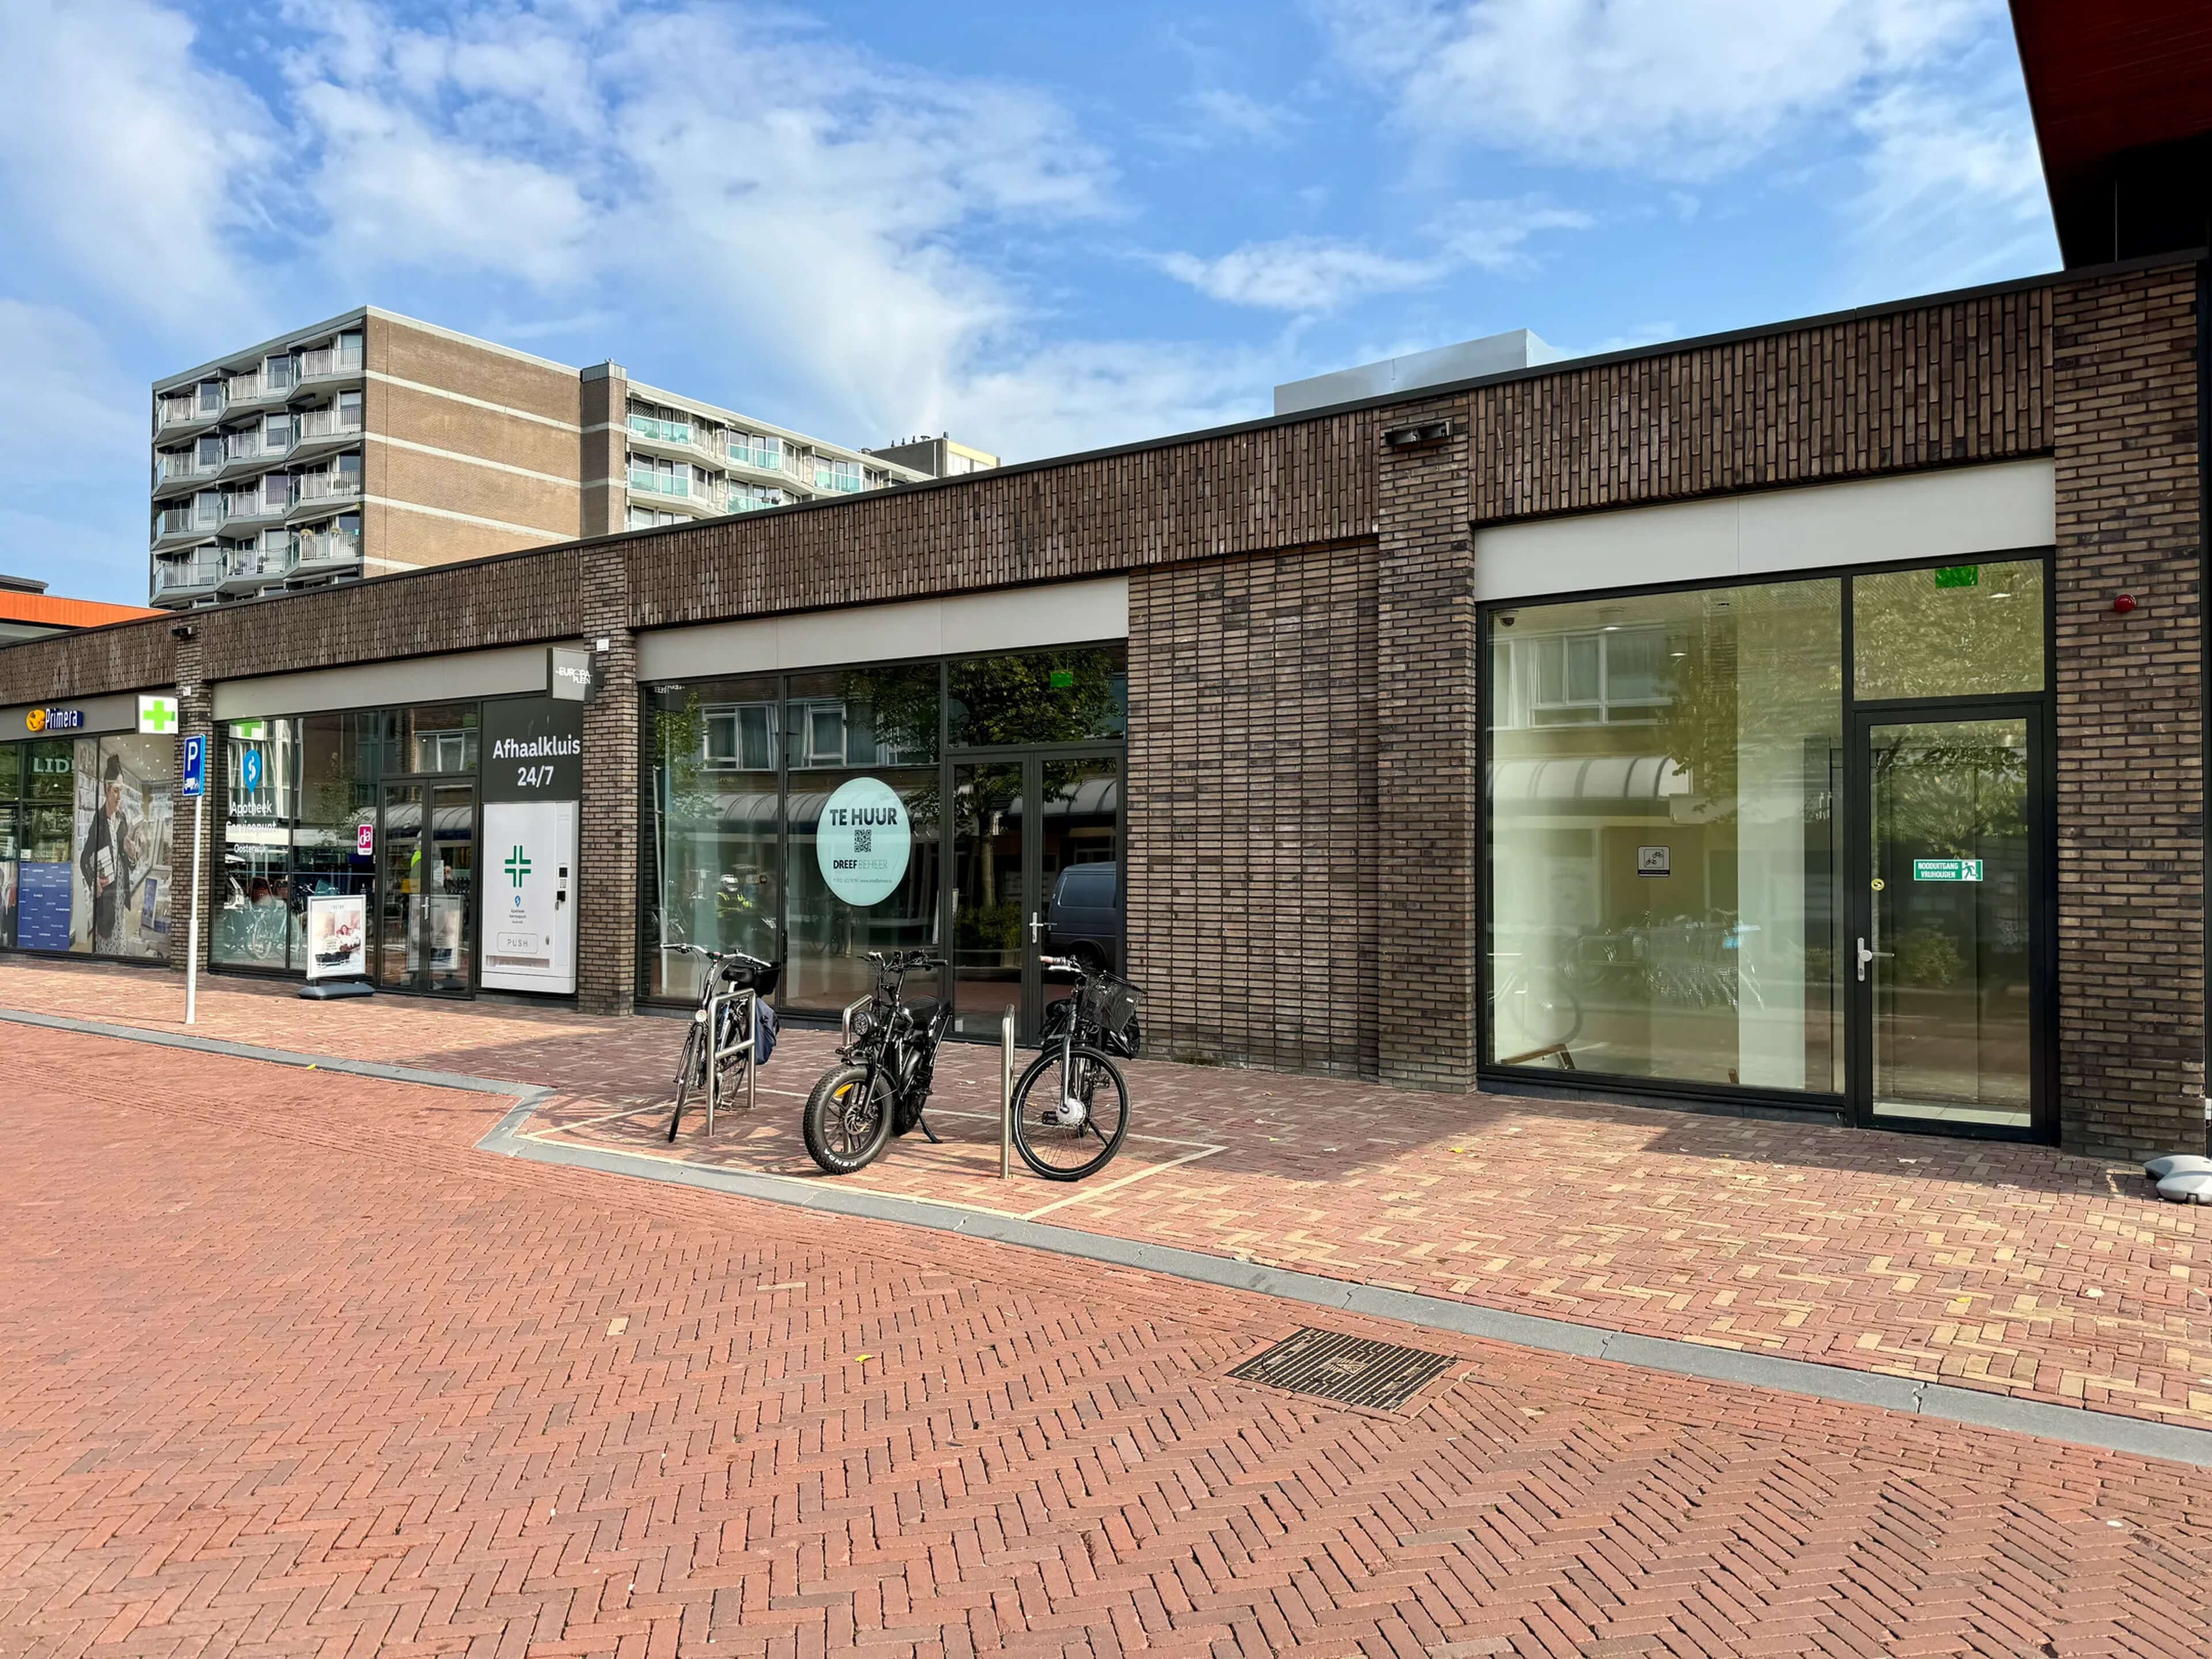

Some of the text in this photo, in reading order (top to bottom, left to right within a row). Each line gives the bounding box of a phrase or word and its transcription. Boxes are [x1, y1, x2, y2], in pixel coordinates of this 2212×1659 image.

[559, 667, 590, 677] EUROPA
[46, 708, 77, 729] Primera
[493, 734, 581, 759] Afhaalkluis
[187, 742, 198, 771] P
[33, 757, 74, 774] LID
[517, 765, 554, 788] 24/7
[232, 800, 272, 817] Apotheek
[830, 808, 897, 826] TE HUUR
[360, 829, 370, 845] da
[833, 859, 888, 869] DREEF BEHEER
[1918, 862, 1959, 870] NOODUITGANG
[507, 939, 528, 947] PUSH
[824, 1147, 858, 1167] KENDA
